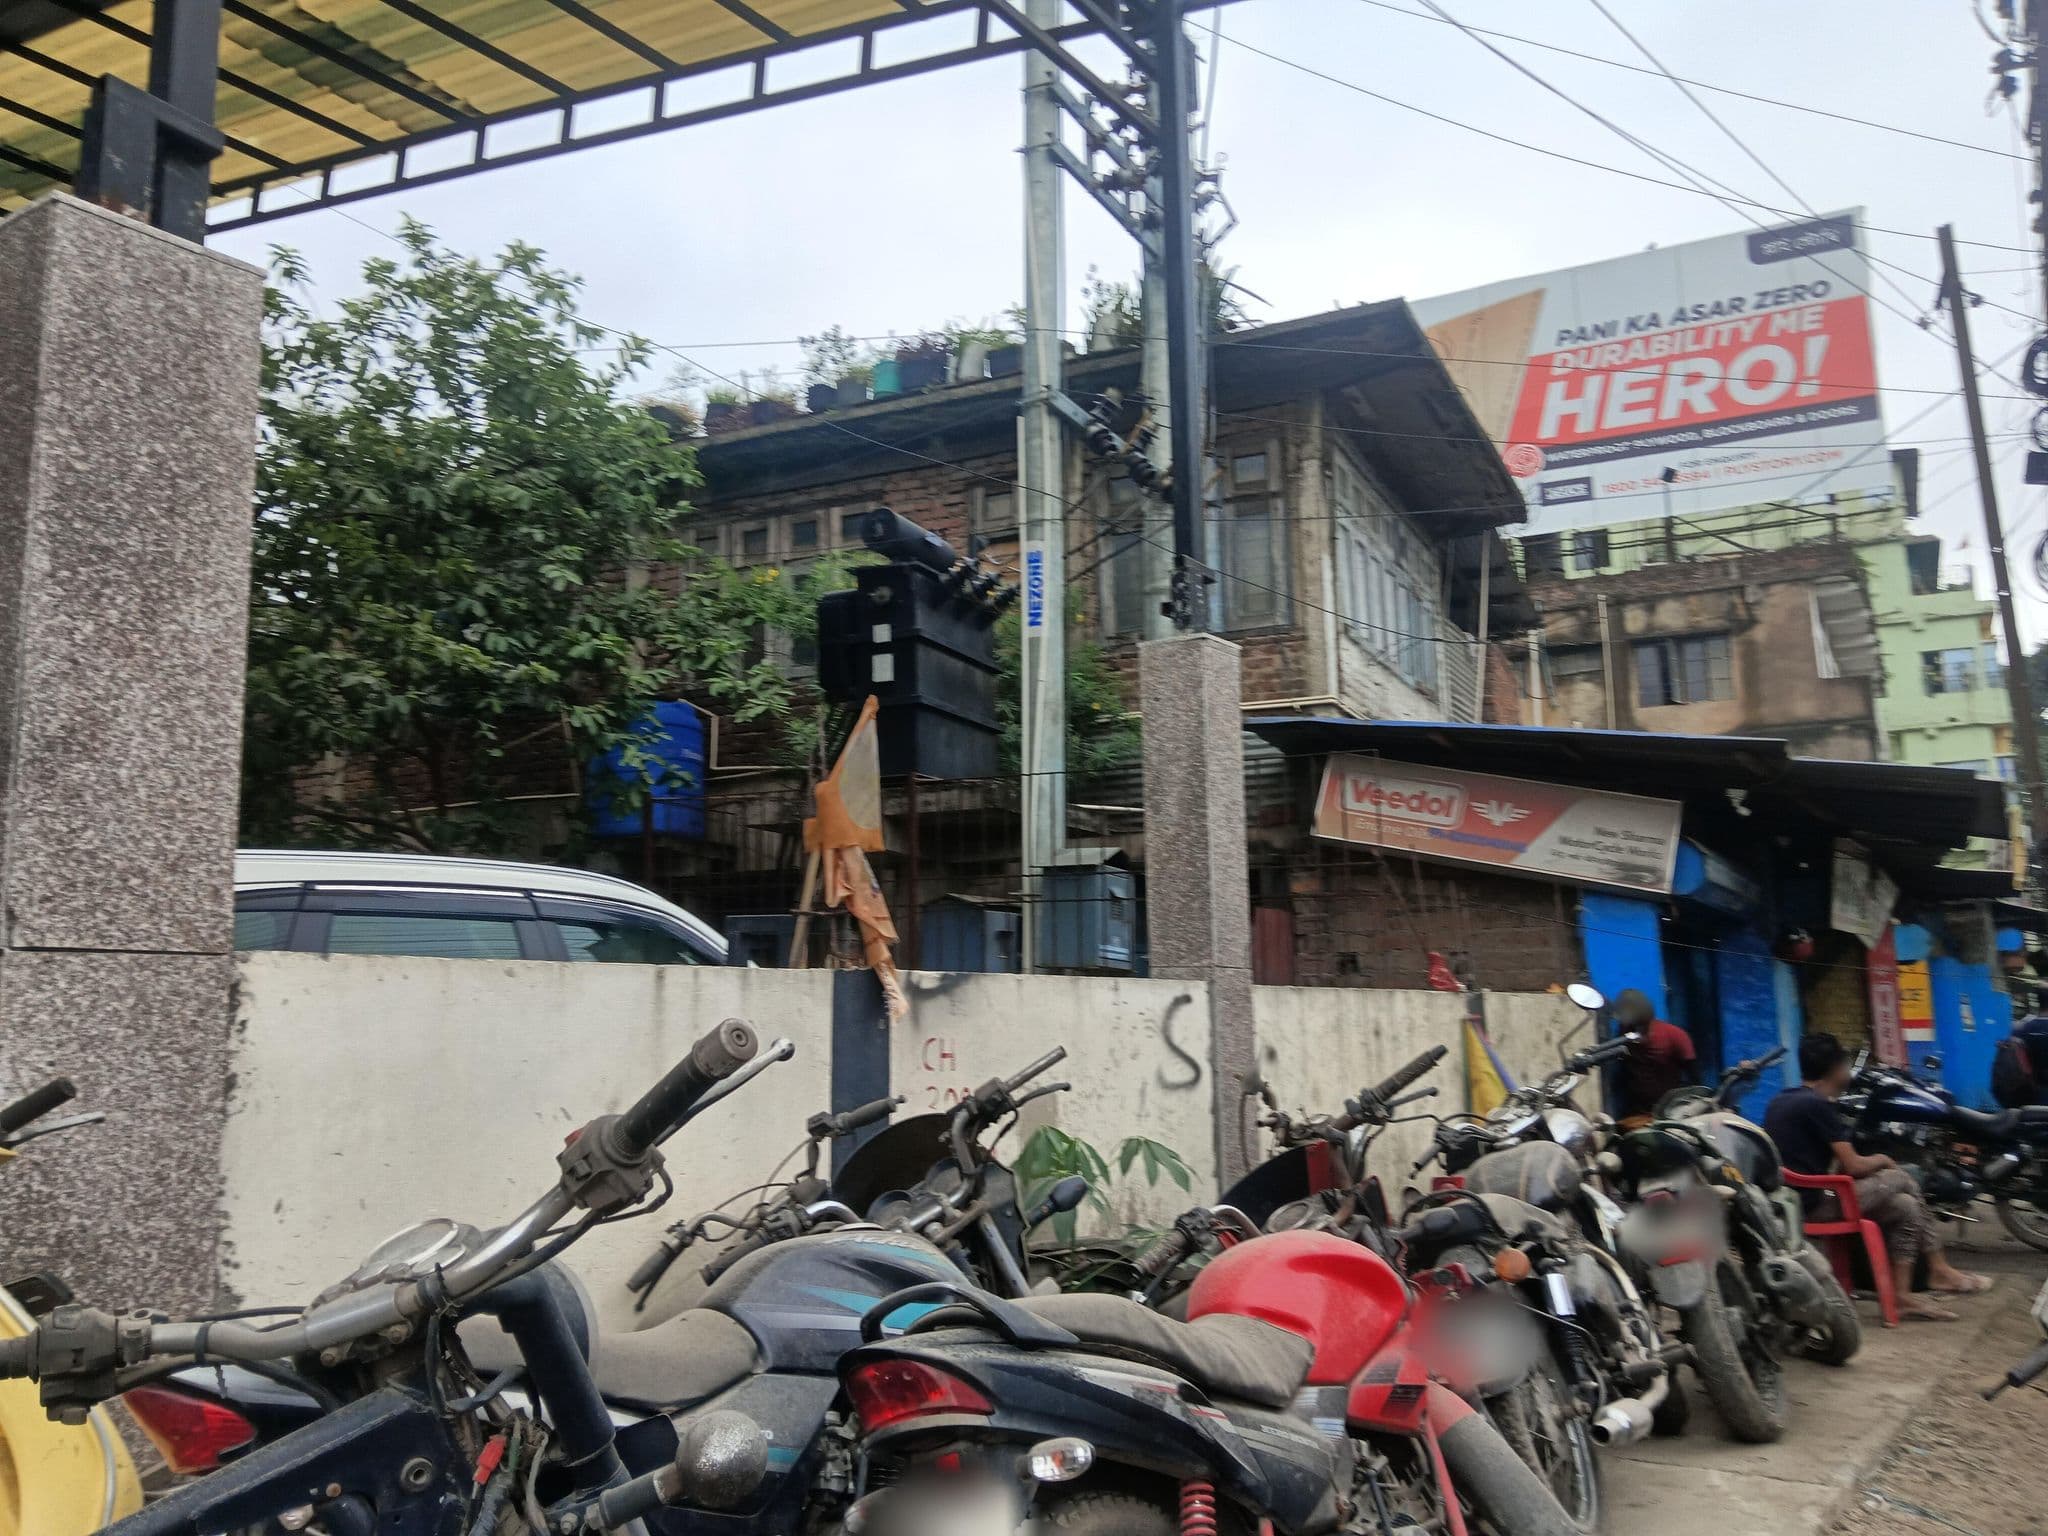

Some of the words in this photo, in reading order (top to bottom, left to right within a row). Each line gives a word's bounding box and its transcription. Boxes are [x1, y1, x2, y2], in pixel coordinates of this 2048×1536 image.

[1551, 317, 1763, 376] DURABILITY
[1768, 304, 1826, 336] ME
[1555, 319, 1620, 347] PANI
[1624, 312, 1661, 334] KA
[1670, 296, 1747, 325] ASAR
[1753, 280, 1831, 310] ZERO
[1537, 334, 1830, 439] HERO!
[1026, 550, 1043, 627] NEZONE
[1351, 779, 1457, 818] Veedol
[921, 1037, 956, 1072] CH
